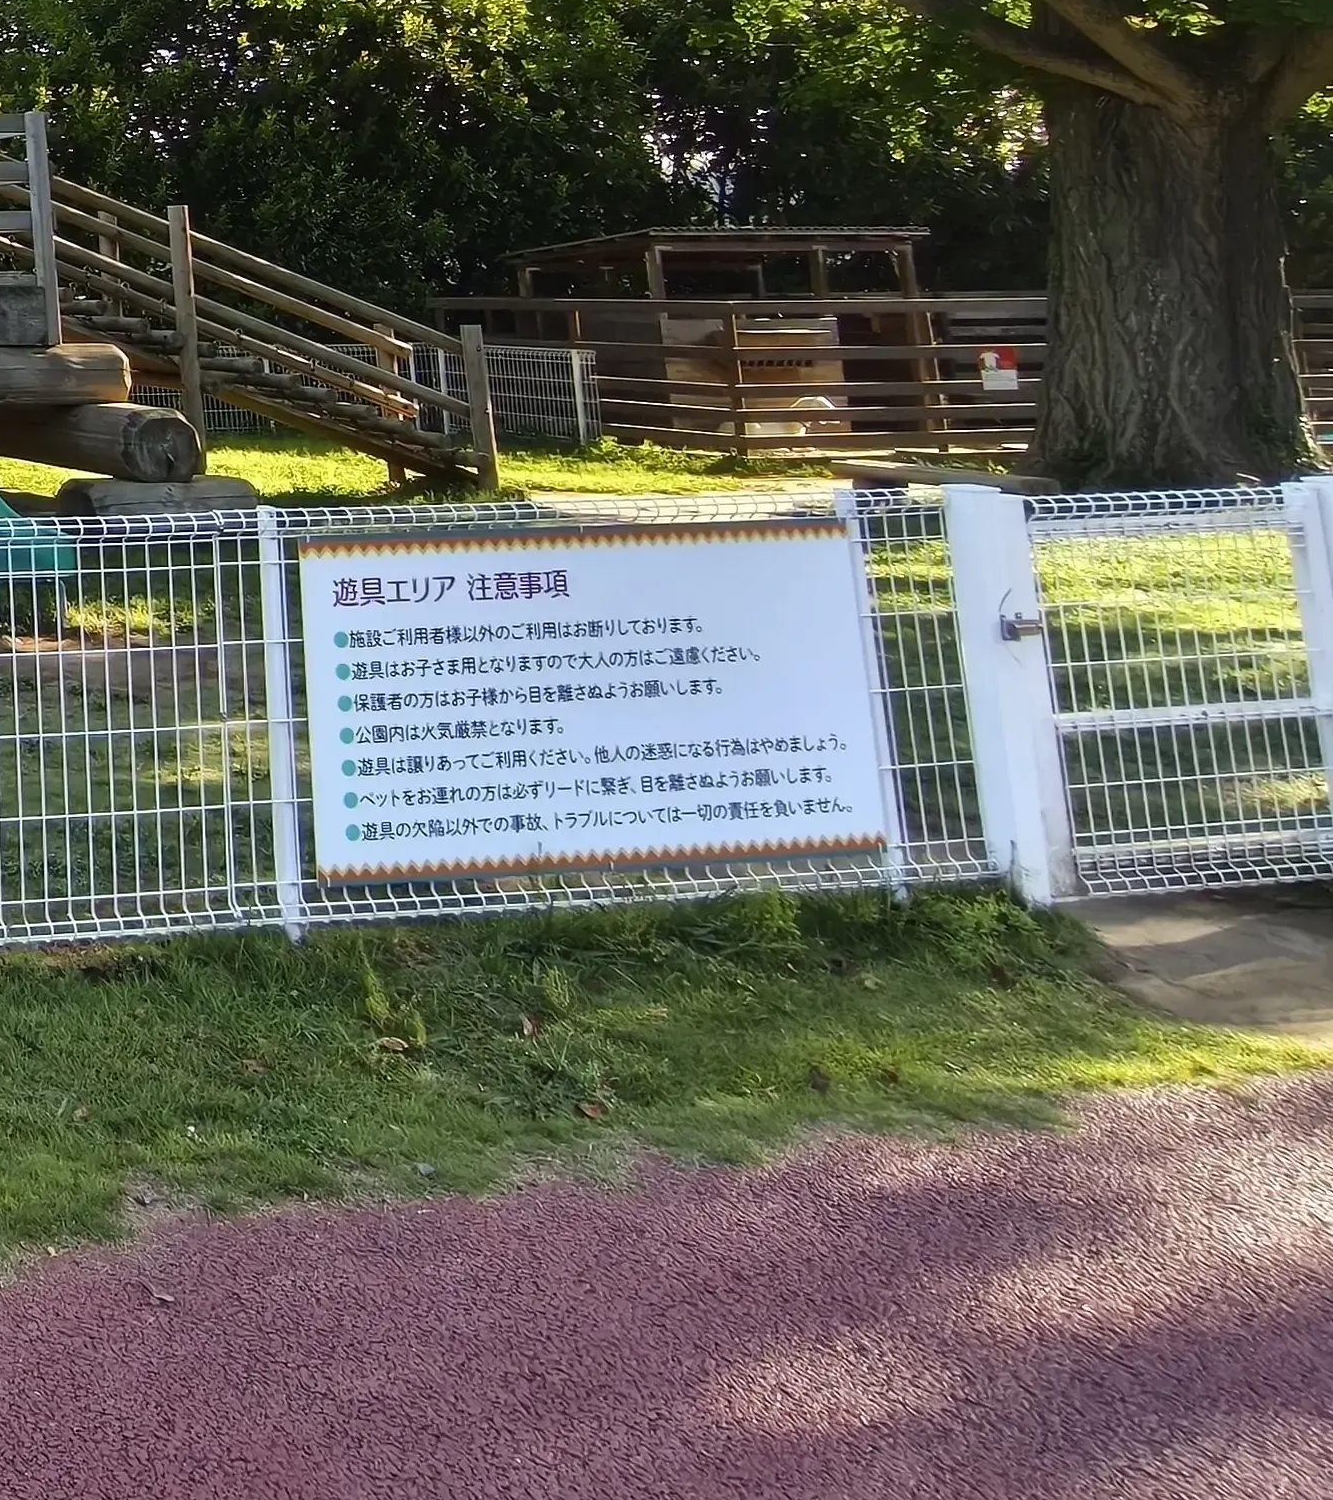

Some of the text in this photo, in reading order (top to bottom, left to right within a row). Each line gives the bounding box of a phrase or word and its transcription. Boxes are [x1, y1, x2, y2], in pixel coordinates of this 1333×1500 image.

[332, 569, 570, 608] 遊具エリア 注意事項
[349, 615, 703, 649] 施設ご利用者様以外のご利用はお断りしております。
[351, 646, 761, 681] 遊具はお子さま用となりますので大人の方はご遠慮ください。
[353, 678, 722, 713] 保護者の方はお子様から目を離さぬようお願いします。
[355, 716, 564, 745] 公園内は火気厳禁となります。
